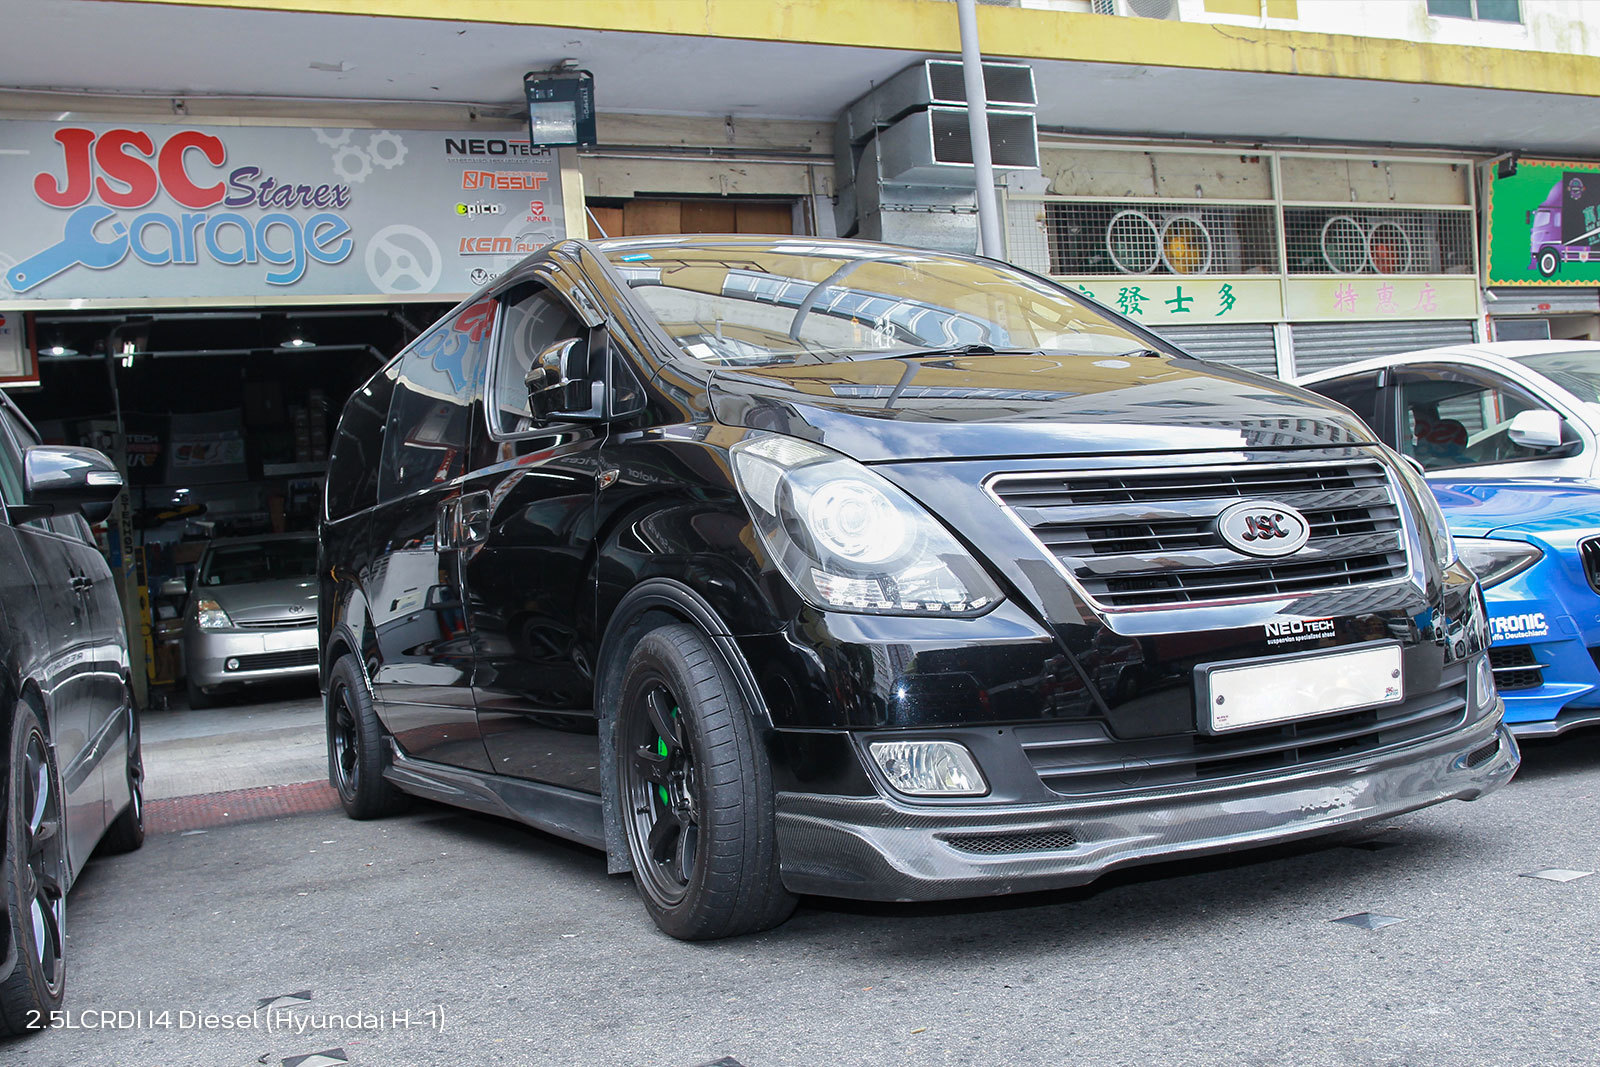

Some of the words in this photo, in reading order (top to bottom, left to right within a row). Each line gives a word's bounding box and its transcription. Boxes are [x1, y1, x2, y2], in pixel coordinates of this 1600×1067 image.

[33, 127, 227, 210] JSC
[224, 166, 352, 210] Starex
[4, 204, 353, 294] Garage
[516, 243, 550, 253] AUT
[1077, 282, 1238, 318] 發士多
[1333, 281, 1439, 315] 特惠店
[1241, 513, 1290, 541] JSC
[1267, 636, 1296, 646] suspension
[1505, 629, 1548, 640] Deutschland
